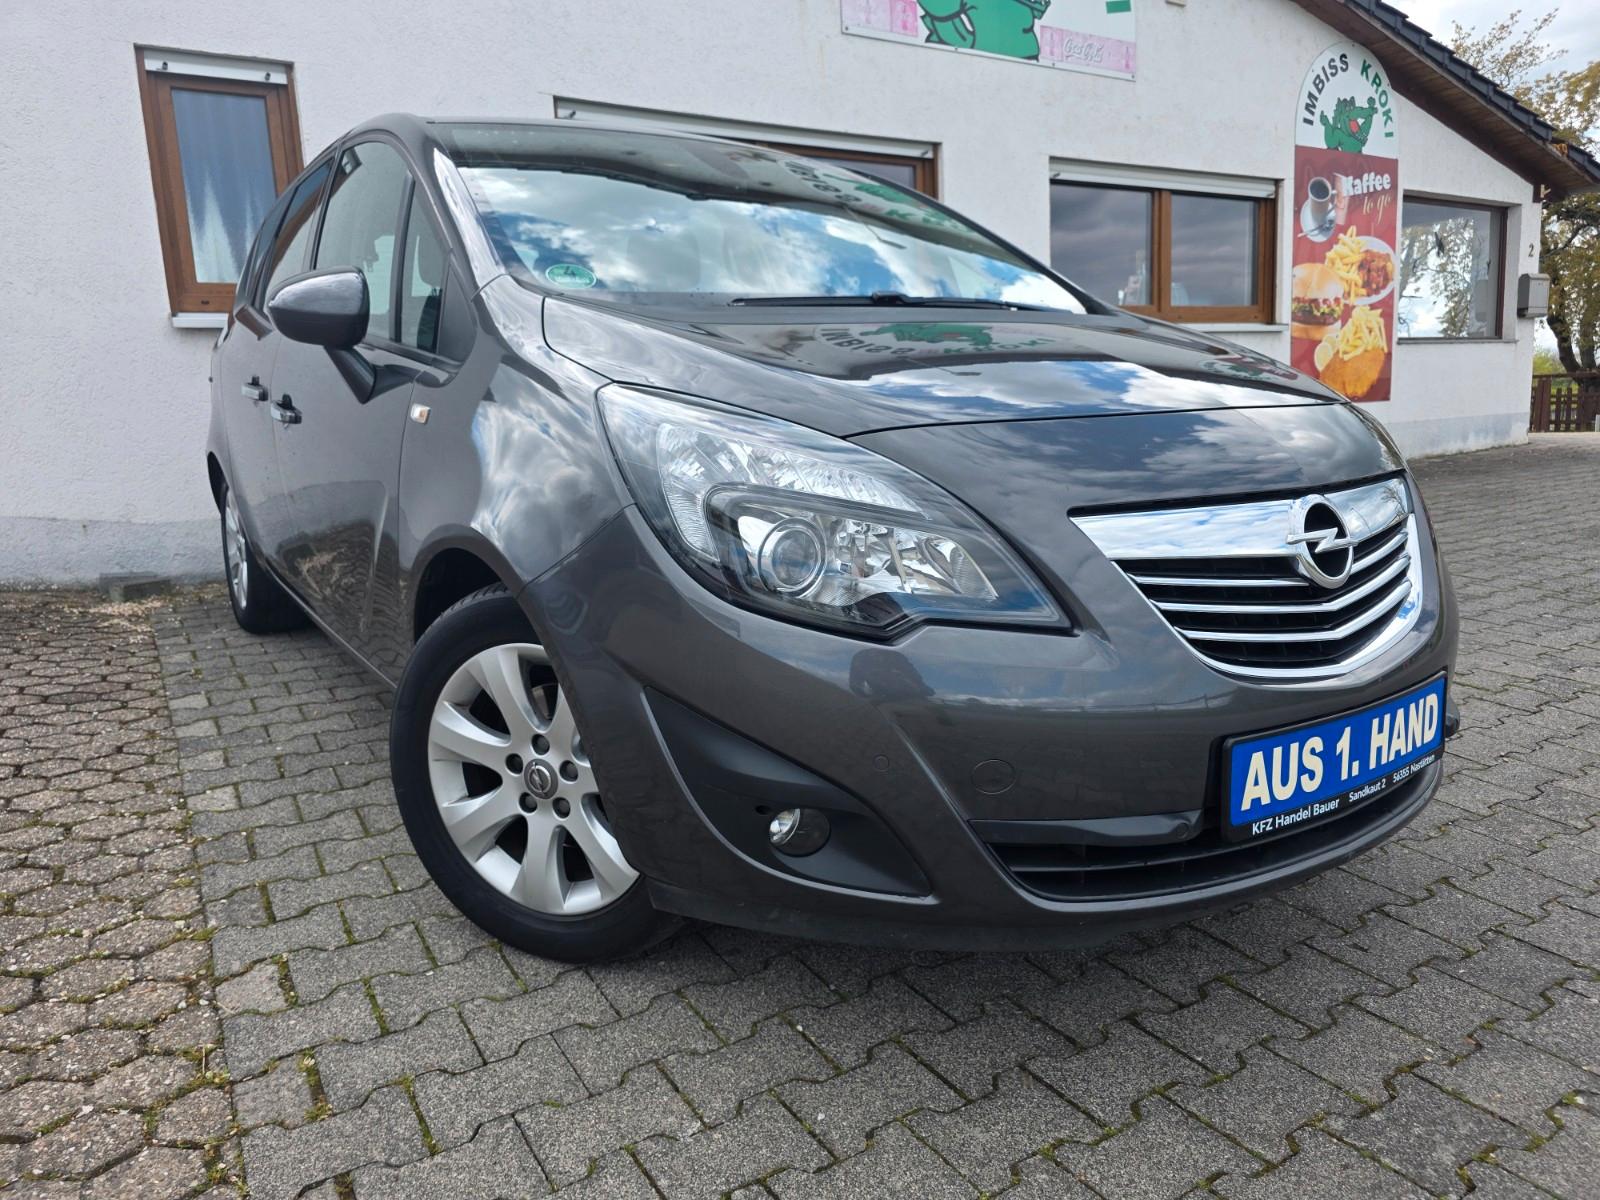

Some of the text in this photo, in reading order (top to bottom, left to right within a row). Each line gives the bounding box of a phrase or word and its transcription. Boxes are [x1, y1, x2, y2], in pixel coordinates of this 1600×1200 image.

[1303, 53, 1394, 138] IMBISS KROKI
[1342, 172, 1391, 197] Kaffee
[1528, 243, 1534, 258] 2
[1241, 693, 1439, 811] AUS 1. HAND
[1252, 818, 1273, 836] KFZ
[1275, 805, 1311, 829] Handel
[1313, 799, 1340, 816] Bauer
[1348, 781, 1381, 802] Sandkaut
[1381, 778, 1386, 789] 2
